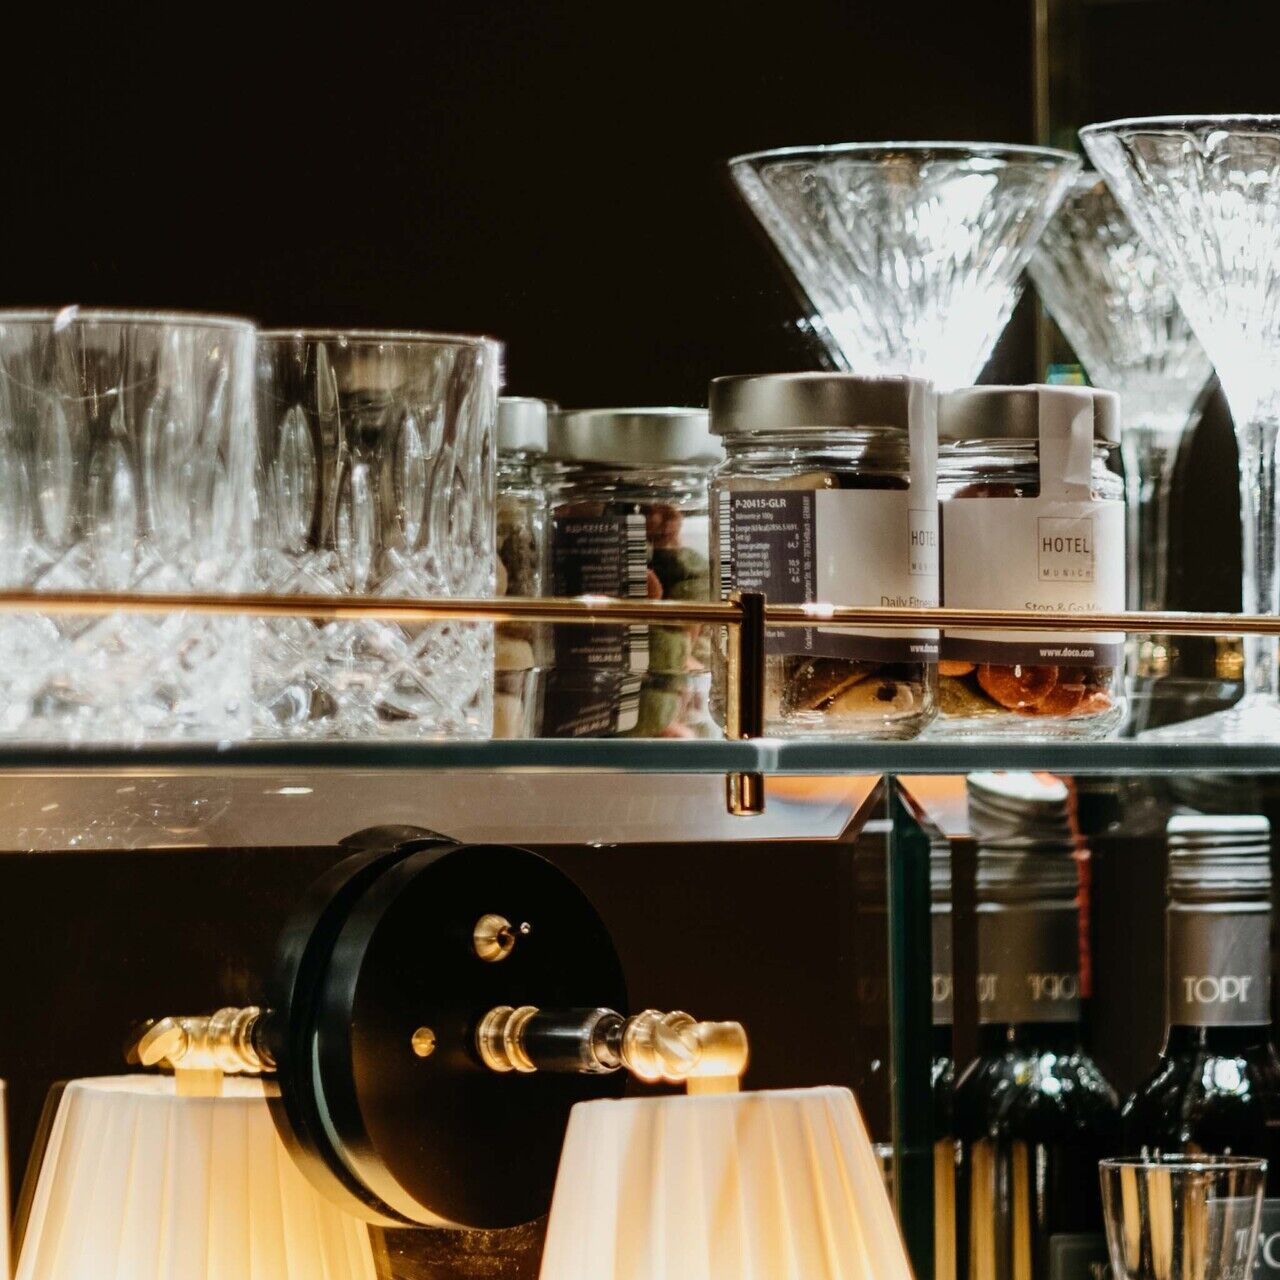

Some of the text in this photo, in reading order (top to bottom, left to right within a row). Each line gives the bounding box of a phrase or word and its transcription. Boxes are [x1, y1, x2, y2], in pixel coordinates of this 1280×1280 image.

[735, 498, 786, 509] P-20415-GLR
[1043, 537, 1090, 554] HOTEL
[1043, 568, 1091, 577] MUNICH
[1040, 647, 1095, 658] www.doco.com
[1183, 974, 1251, 1004] TOPF
